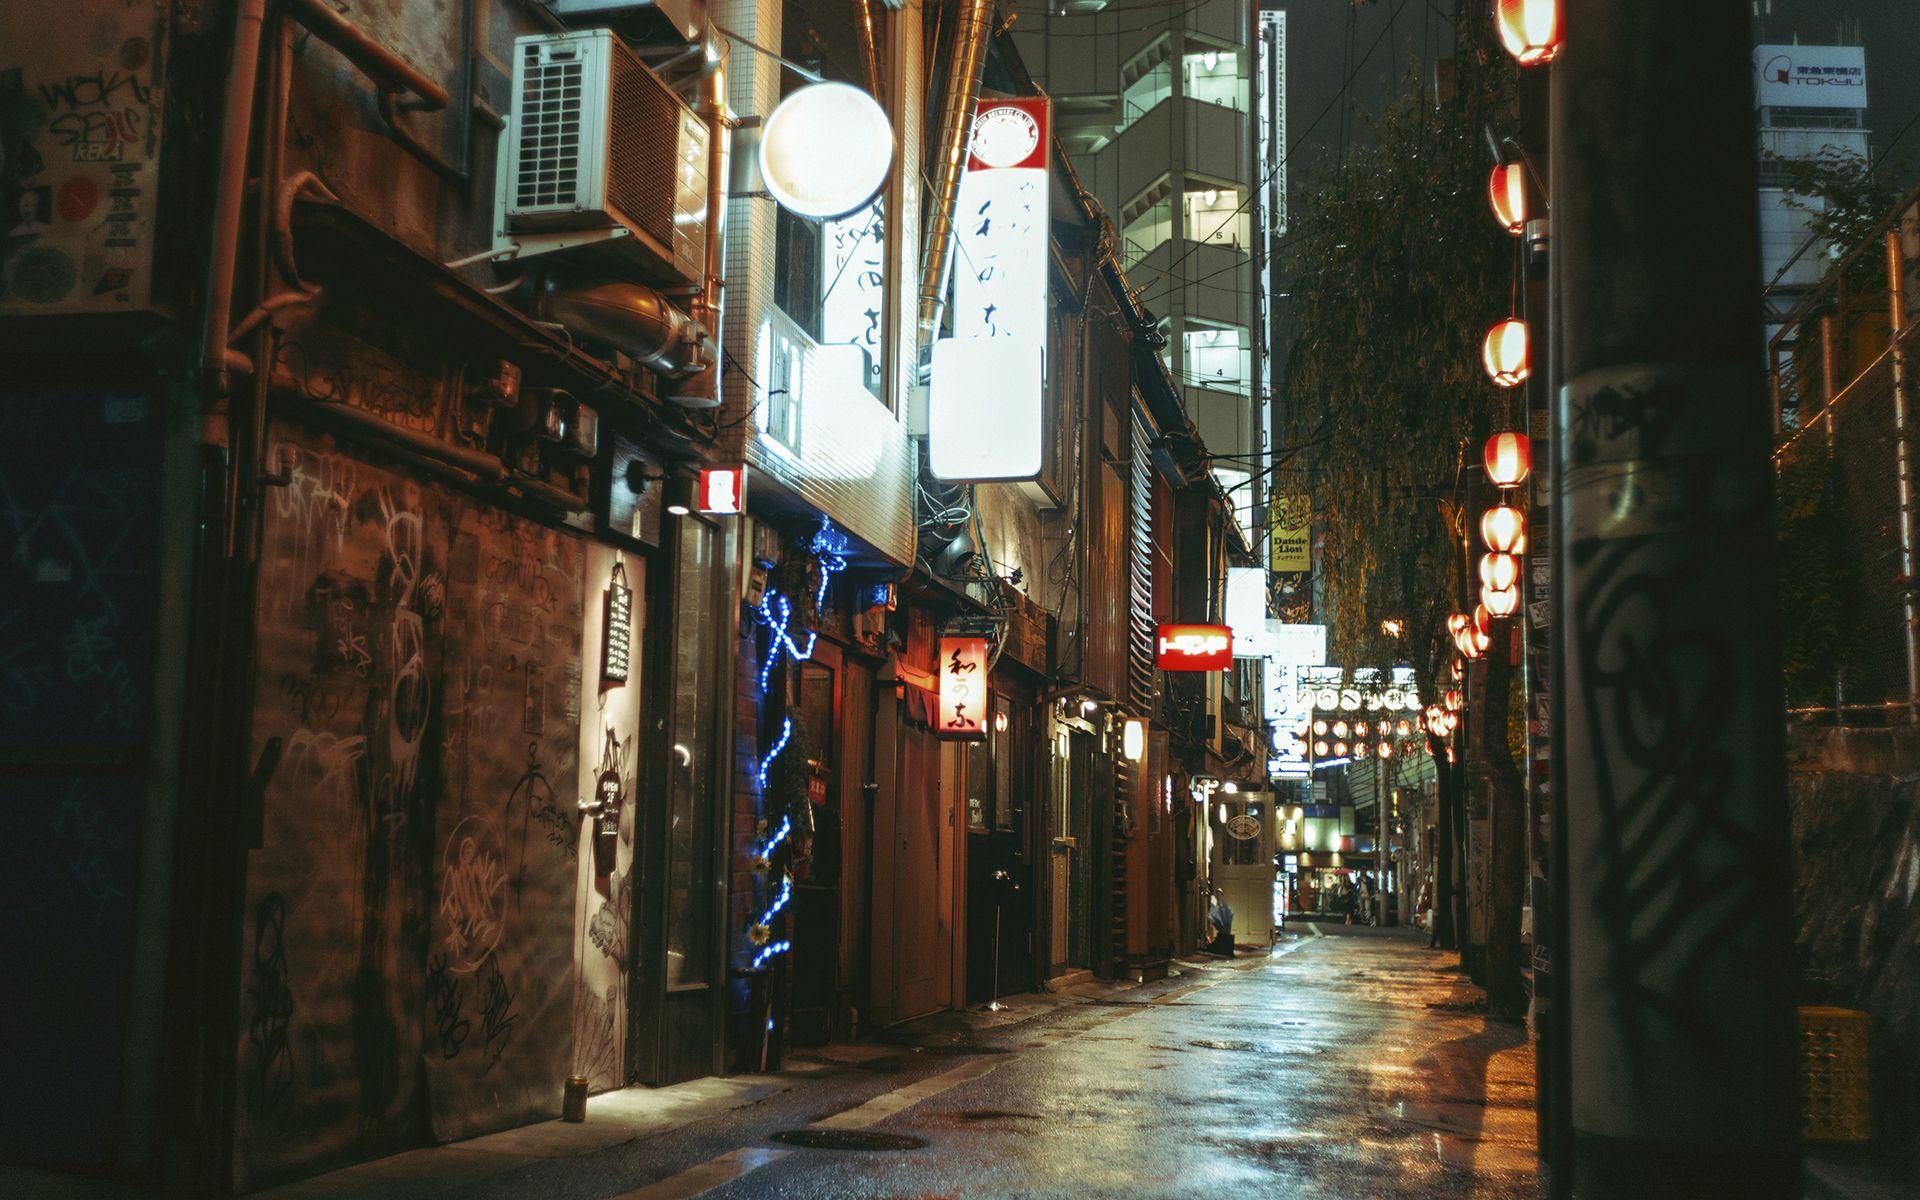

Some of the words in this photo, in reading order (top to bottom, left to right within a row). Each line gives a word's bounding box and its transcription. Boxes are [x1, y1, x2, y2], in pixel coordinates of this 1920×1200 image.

[1791, 77, 1864, 86] TOKYU
[1215, 231, 1223, 240] 5
[1279, 545, 1303, 553] Lion
[603, 781, 619, 792] OPEN
